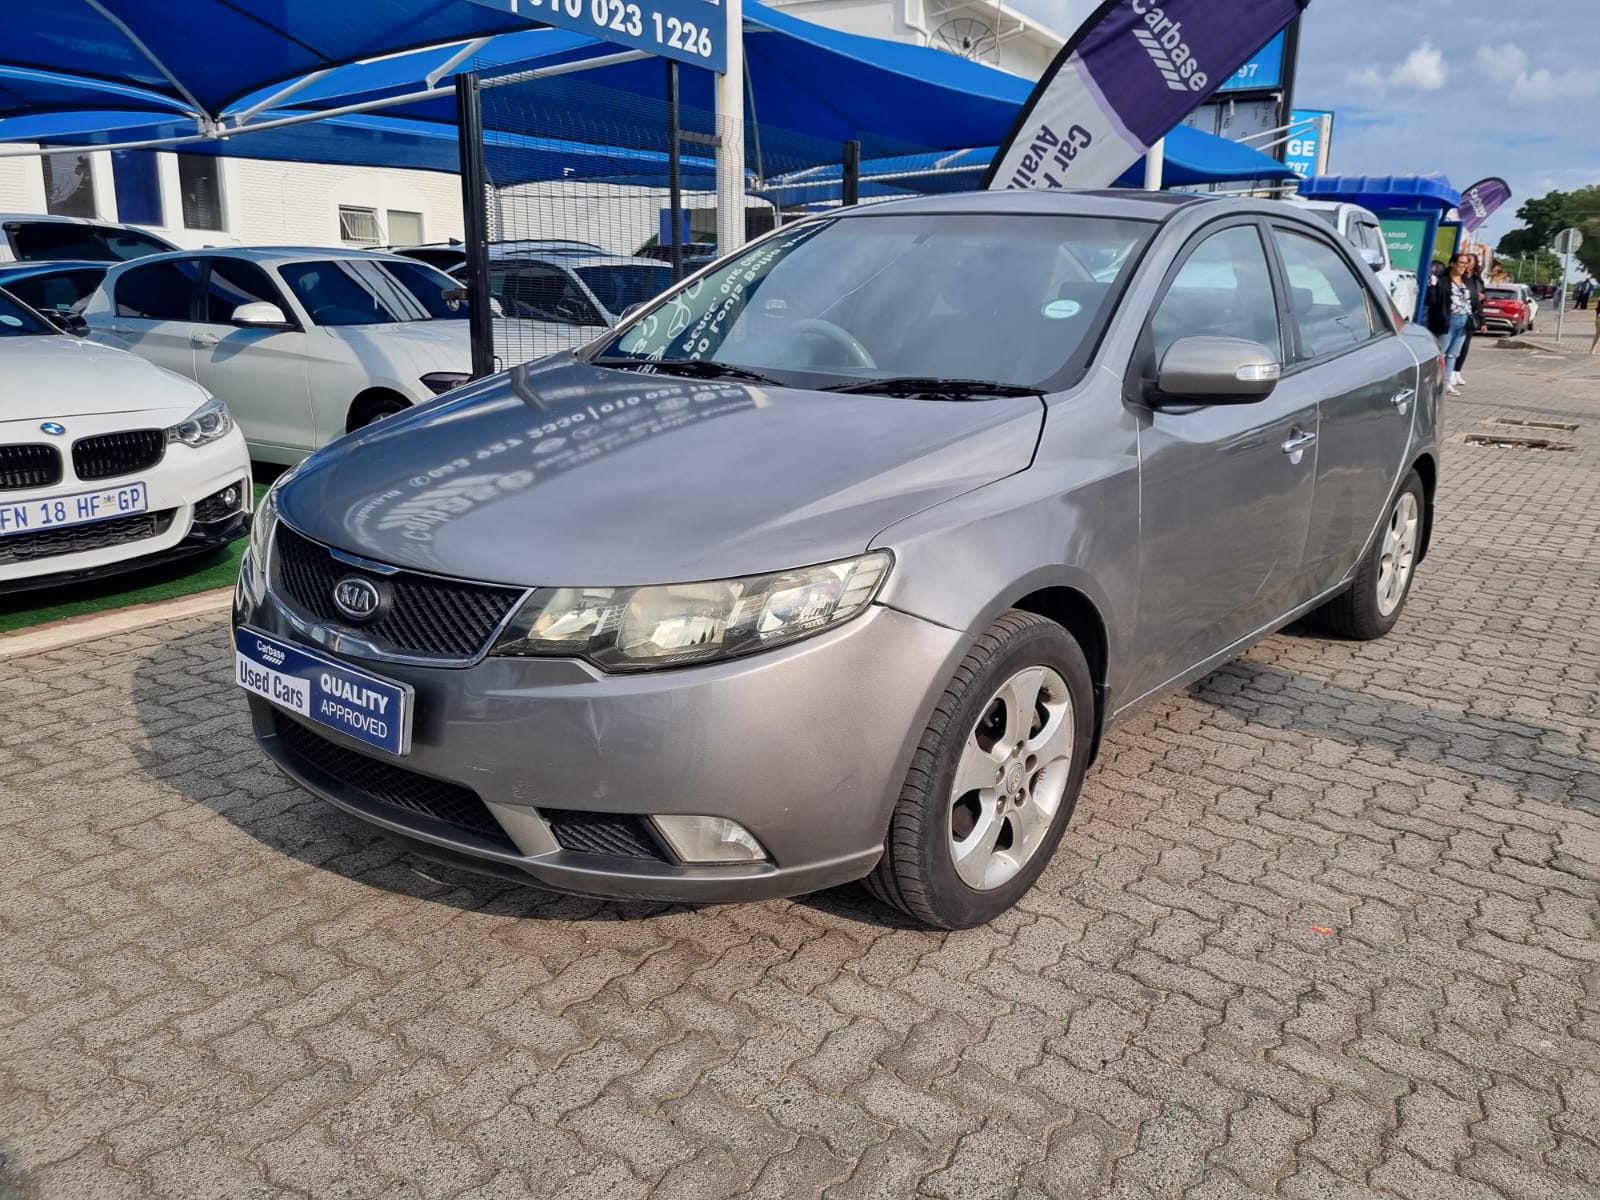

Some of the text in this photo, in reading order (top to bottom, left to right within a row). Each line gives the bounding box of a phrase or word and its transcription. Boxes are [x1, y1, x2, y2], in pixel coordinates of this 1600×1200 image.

[591, 0, 643, 37] 023
[652, 11, 713, 58] 1226
[1132, 0, 1208, 92] Carbase
[1232, 63, 1258, 78] 97
[1006, 124, 1060, 188] Avail
[1053, 124, 1093, 173] Car
[0, 488, 141, 531] FN 18 HF GP
[341, 583, 370, 611] KIA
[257, 639, 286, 661] Carbase
[240, 659, 304, 709] Used Cars
[320, 673, 390, 715] QUALITY
[320, 699, 388, 739] APPROVED
